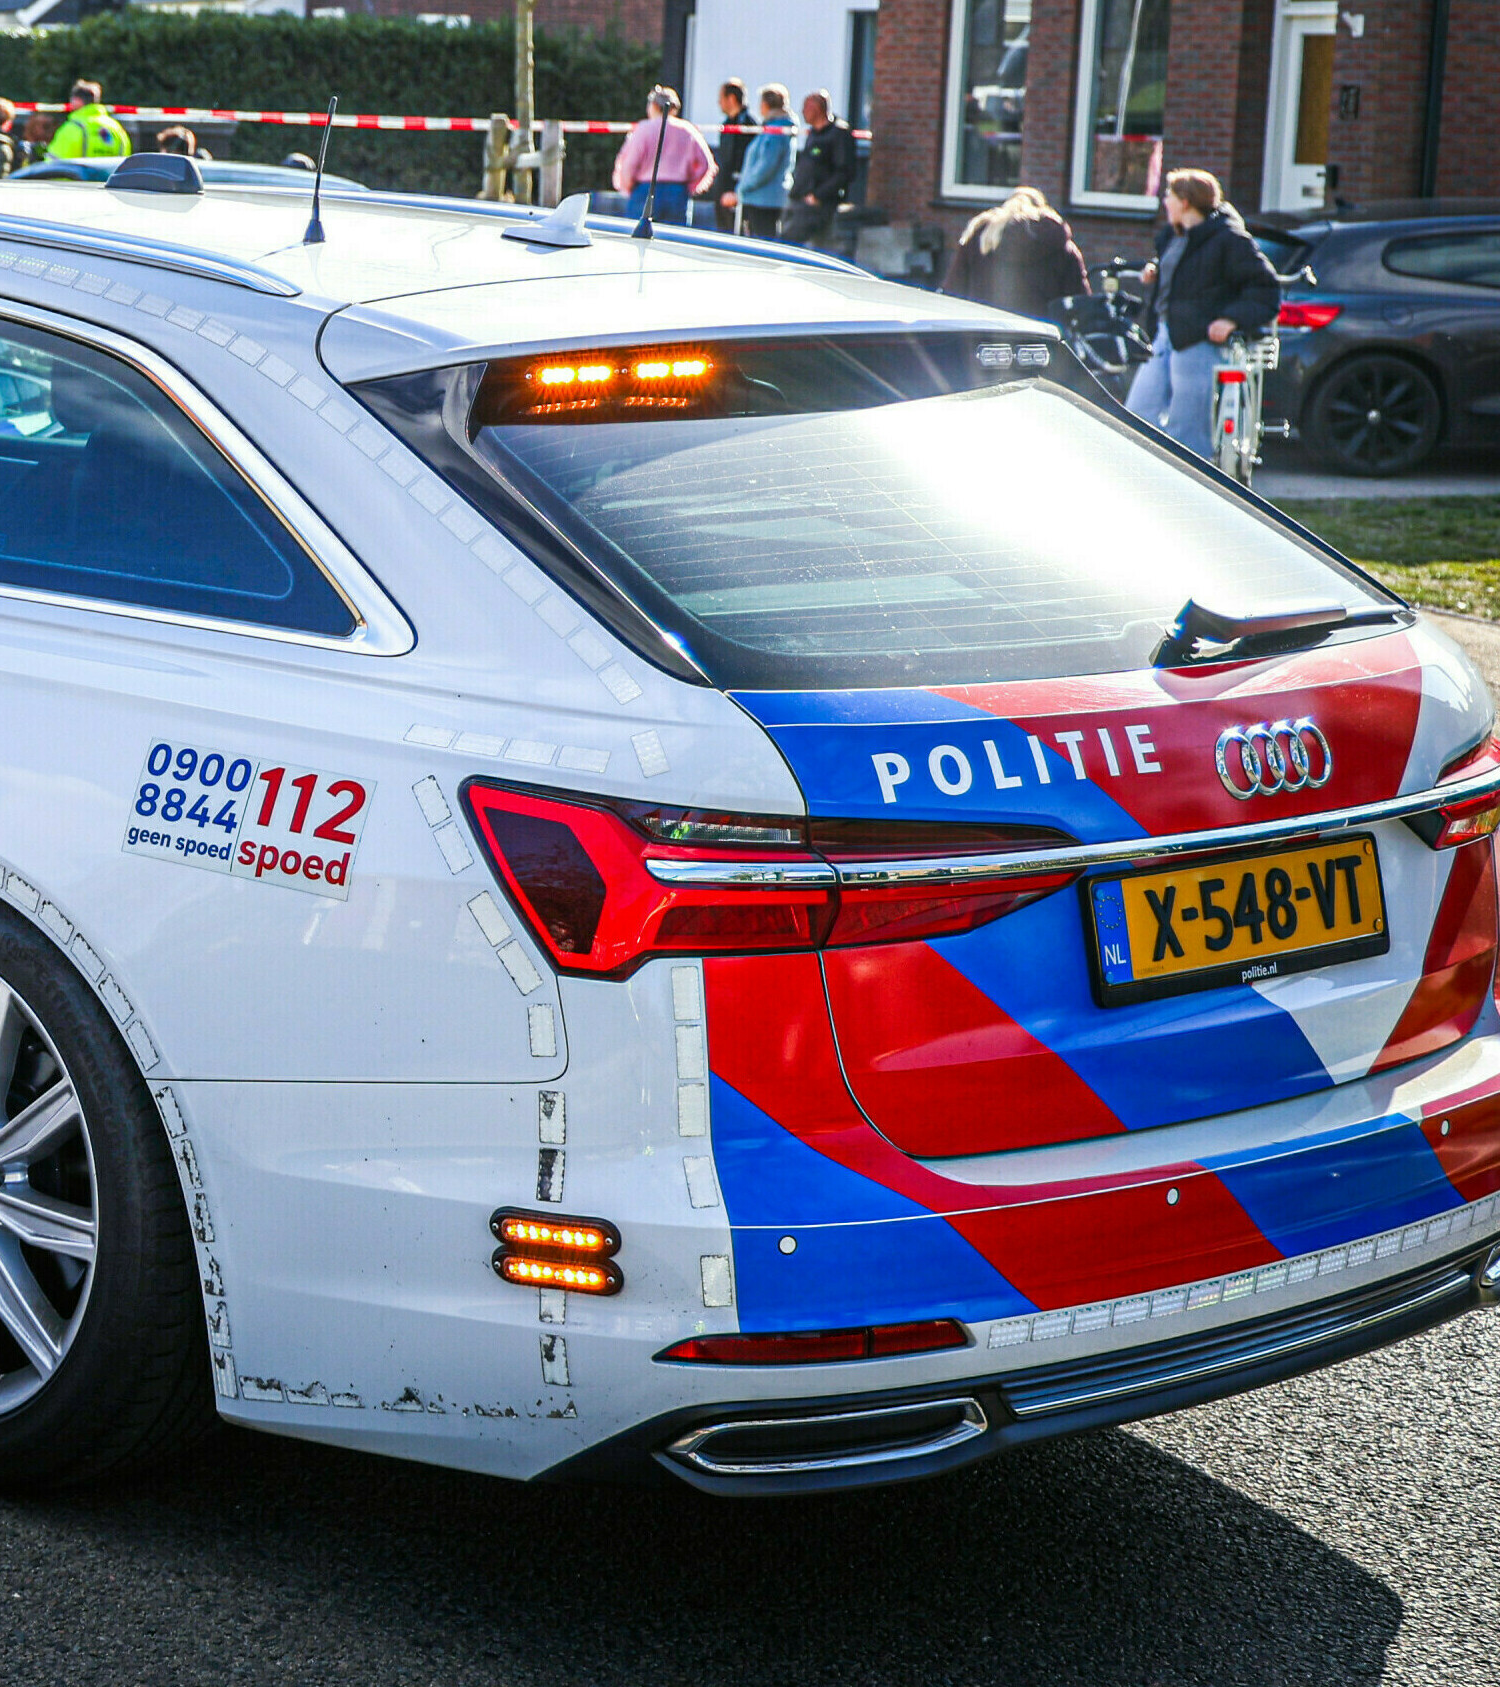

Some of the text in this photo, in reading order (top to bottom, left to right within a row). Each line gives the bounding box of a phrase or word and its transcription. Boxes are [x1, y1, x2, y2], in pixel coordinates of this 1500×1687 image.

[147, 743, 252, 792] 0900
[871, 724, 1163, 803] POLITIE
[135, 782, 238, 834] 8844
[257, 766, 367, 845] 112
[127, 825, 232, 861] geen spoed
[237, 840, 351, 886] spoed
[1143, 854, 1364, 962] X-548-VT
[1104, 944, 1127, 966] NL
[1241, 961, 1278, 983] politie.nl
